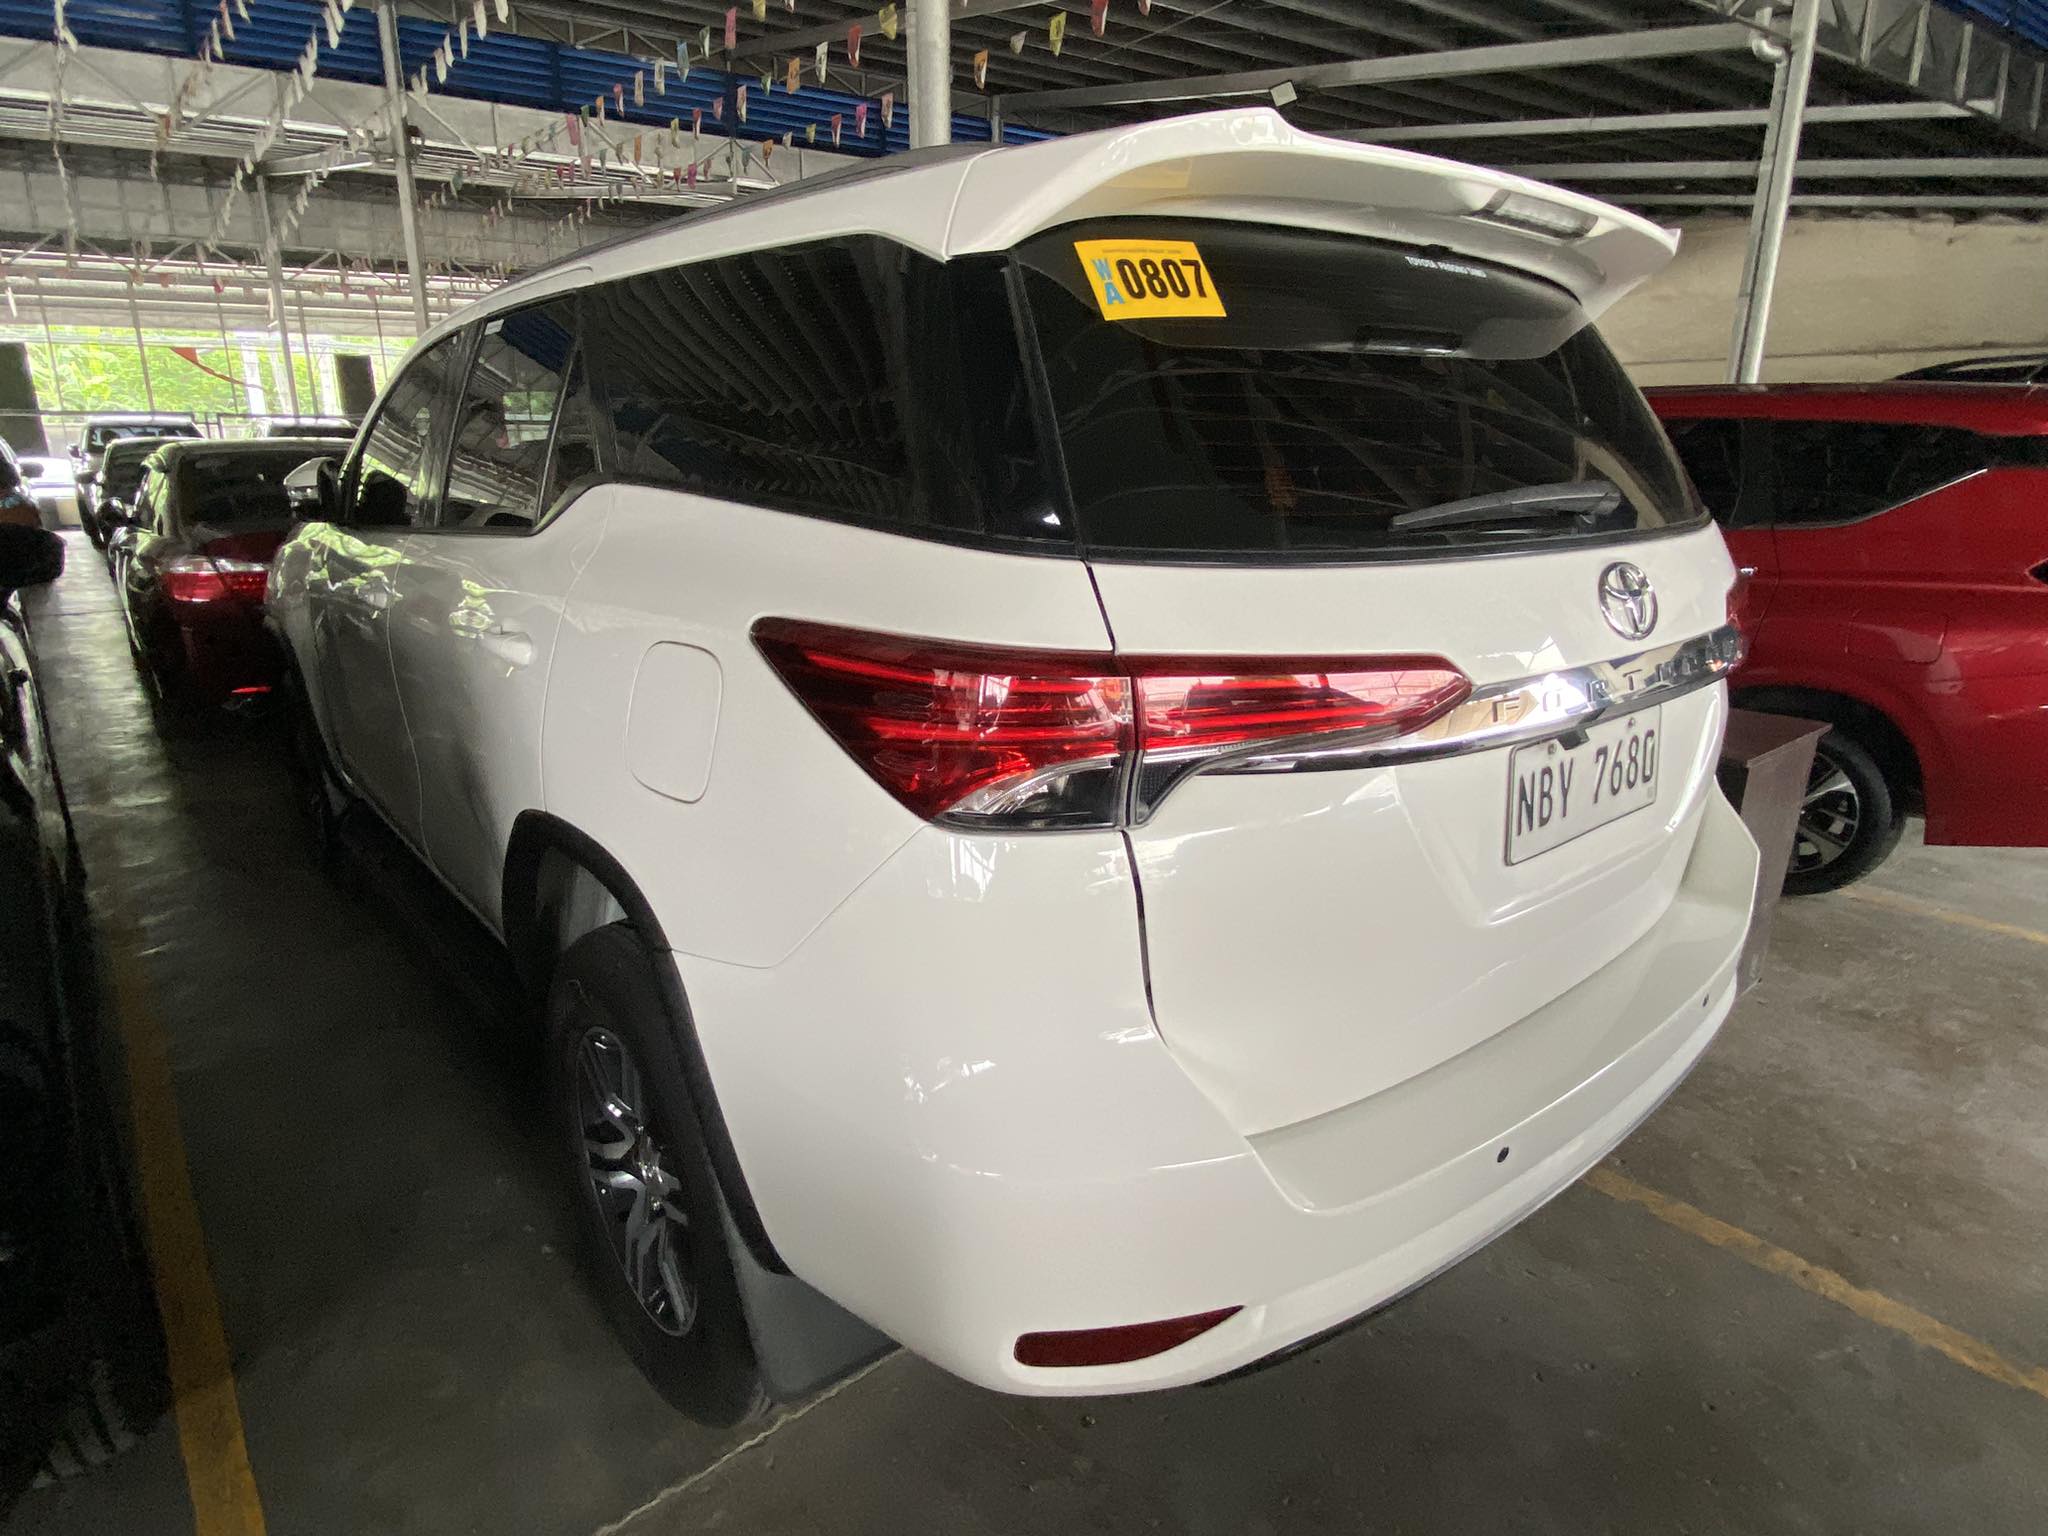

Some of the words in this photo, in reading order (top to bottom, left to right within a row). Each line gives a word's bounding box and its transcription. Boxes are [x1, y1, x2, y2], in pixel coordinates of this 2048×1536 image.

[1115, 258, 1208, 300] 0807
[1516, 757, 1574, 836] NBY
[1592, 729, 1655, 805] 7680
